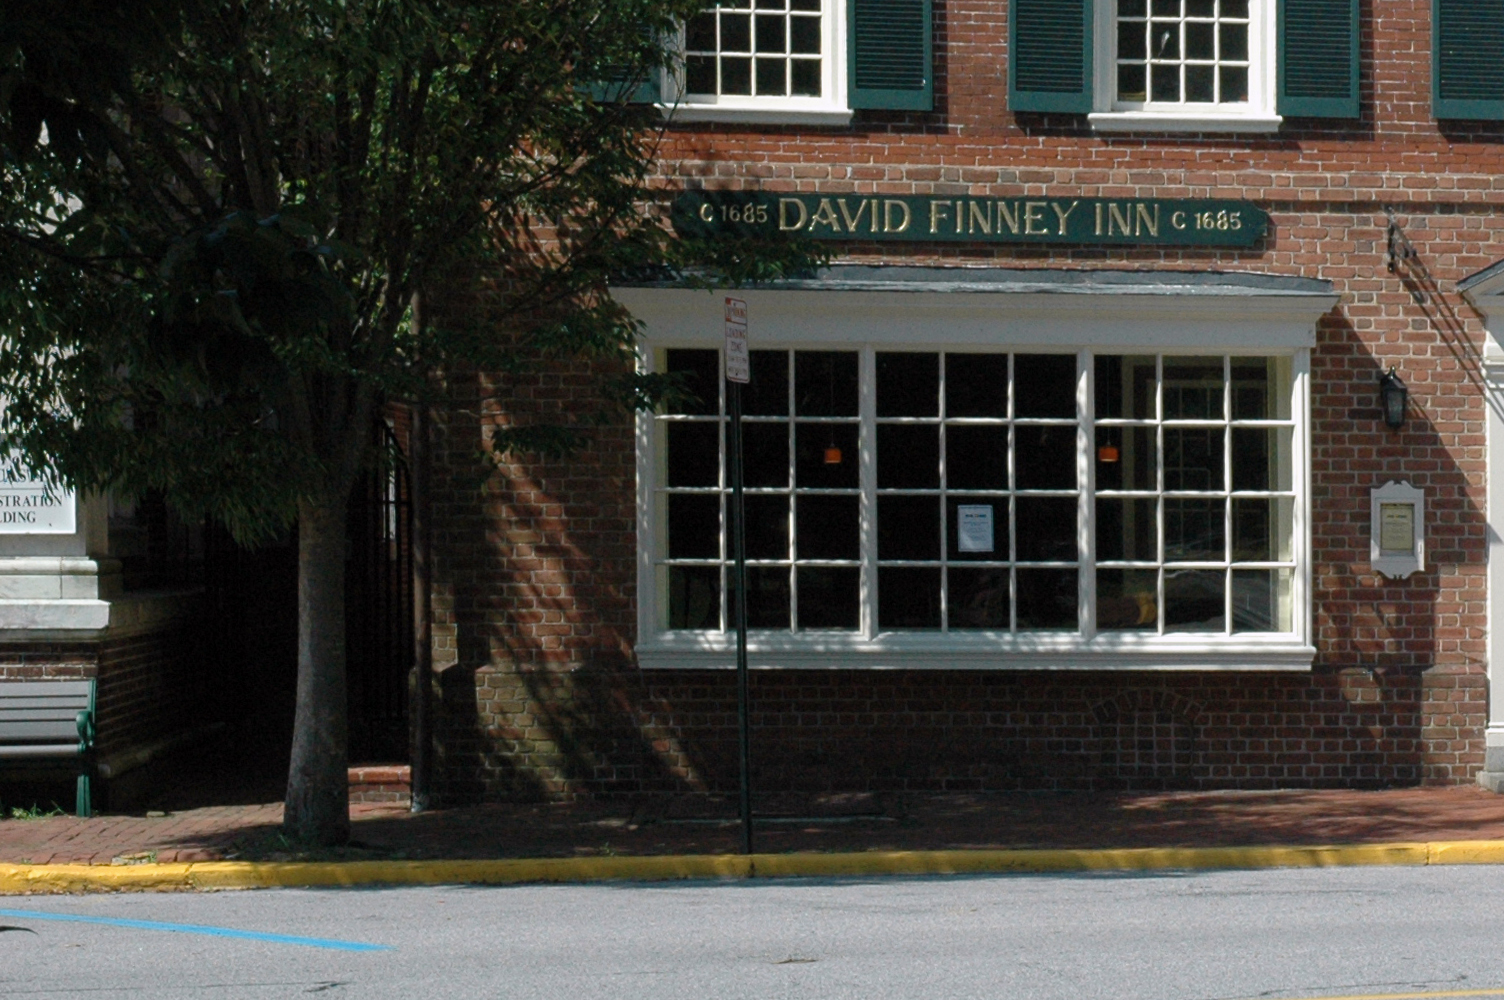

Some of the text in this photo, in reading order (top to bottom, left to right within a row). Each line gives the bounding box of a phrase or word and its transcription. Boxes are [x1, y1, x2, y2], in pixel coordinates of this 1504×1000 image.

[700, 197, 1242, 237] C 1685 DAVID FINNEY INN C 1685
